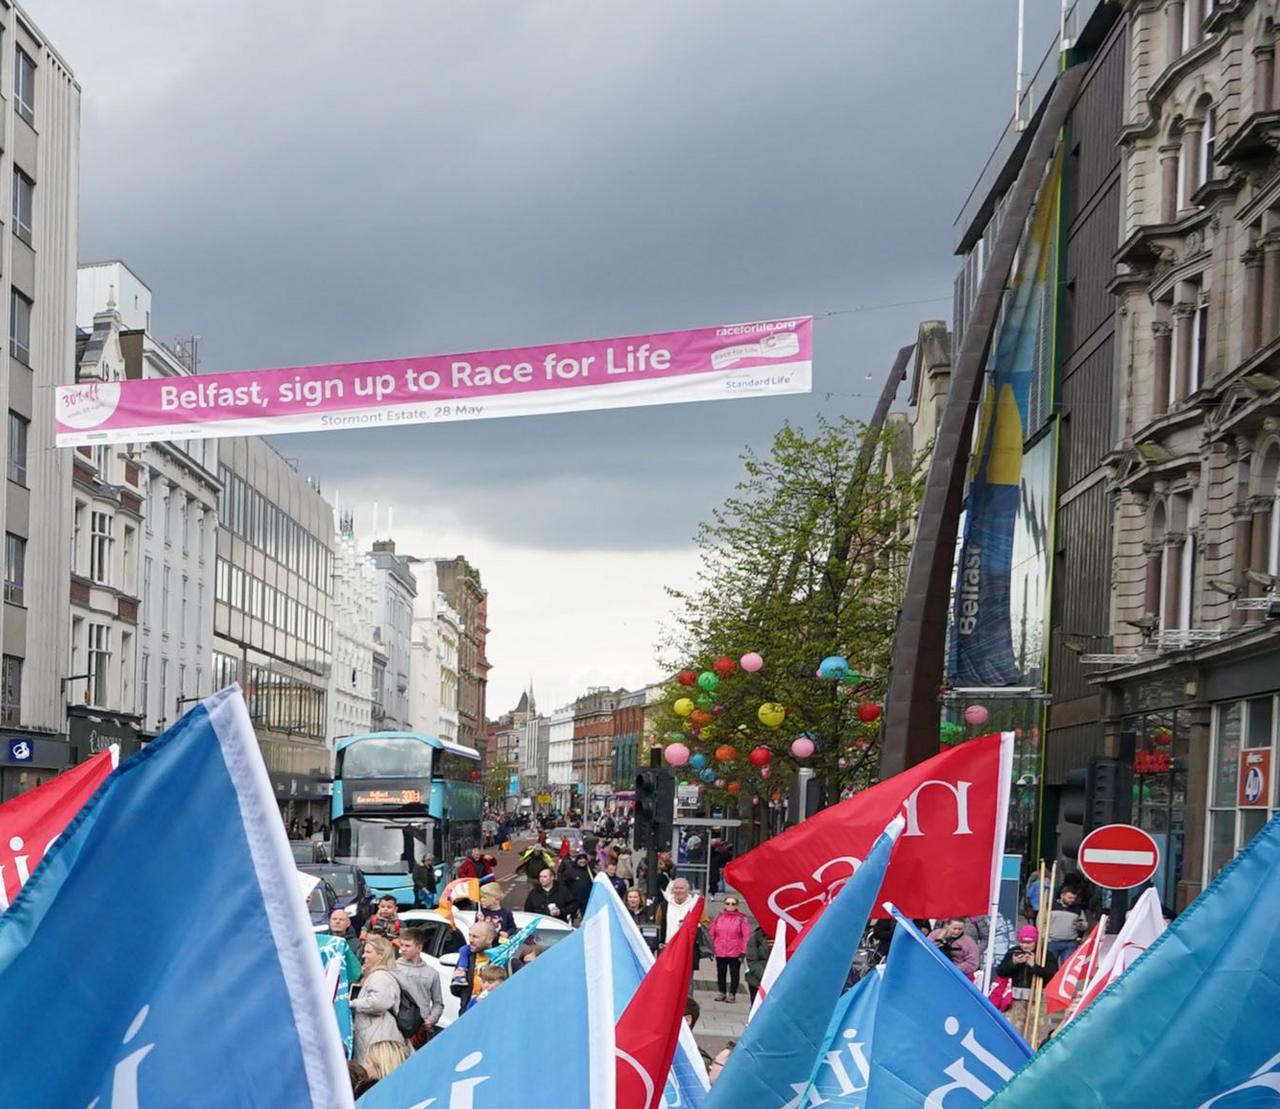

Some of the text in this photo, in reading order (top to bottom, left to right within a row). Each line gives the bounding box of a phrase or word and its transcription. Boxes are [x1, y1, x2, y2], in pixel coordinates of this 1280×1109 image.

[160, 343, 673, 411] Belfast, sign up to Race for Life
[726, 376, 770, 390] Standard
[320, 410, 382, 427] Stormont
[434, 406, 452, 419] 28
[455, 403, 484, 420] May
